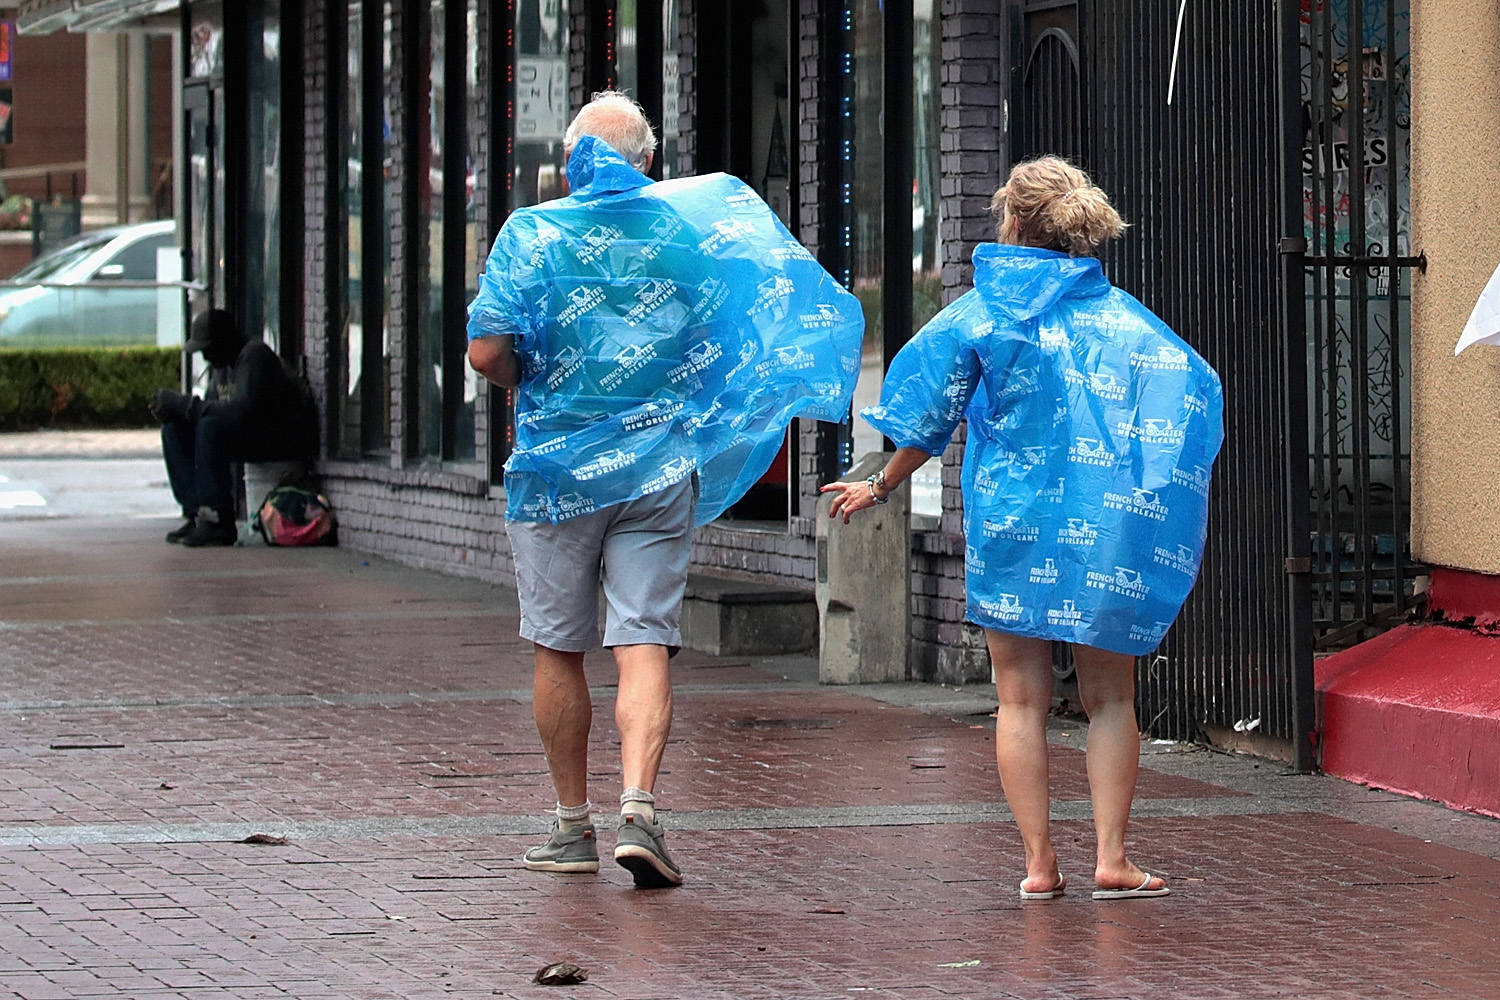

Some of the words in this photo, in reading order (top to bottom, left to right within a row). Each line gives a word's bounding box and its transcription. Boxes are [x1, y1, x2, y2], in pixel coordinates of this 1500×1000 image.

[556, 303, 578, 323] FRENCH
[560, 315, 577, 329] NEW
[576, 294, 608, 320] ORLEANS
[622, 302, 646, 324] FRENCH
[628, 313, 646, 328] NEW
[645, 286, 678, 313] ORLEANS
[670, 369, 691, 384] NEW
[690, 350, 723, 374] ORLEANS
[1129, 351, 1158, 363] FRENCH
[1130, 359, 1152, 368] NEW
[1152, 361, 1193, 373] ORLEANS
[600, 364, 625, 388] FRENCH
[606, 378, 624, 393] NEW
[624, 351, 658, 380] ORLEANS
[666, 361, 692, 379] FRENCH
[1117, 422, 1145, 436] FRENCH
[1117, 428, 1138, 440] NEW
[1139, 433, 1182, 444] ORLEANS
[571, 464, 600, 476] FRENCH
[575, 471, 595, 481] NEW
[596, 457, 637, 476] ORLEANS
[1103, 491, 1132, 505] FRENCH
[1102, 499, 1125, 512] NEW
[1126, 505, 1167, 522] ORLEANS
[1086, 570, 1115, 585] FRENCH
[1085, 579, 1107, 590] NEW
[1108, 583, 1147, 601] ORLEANS
